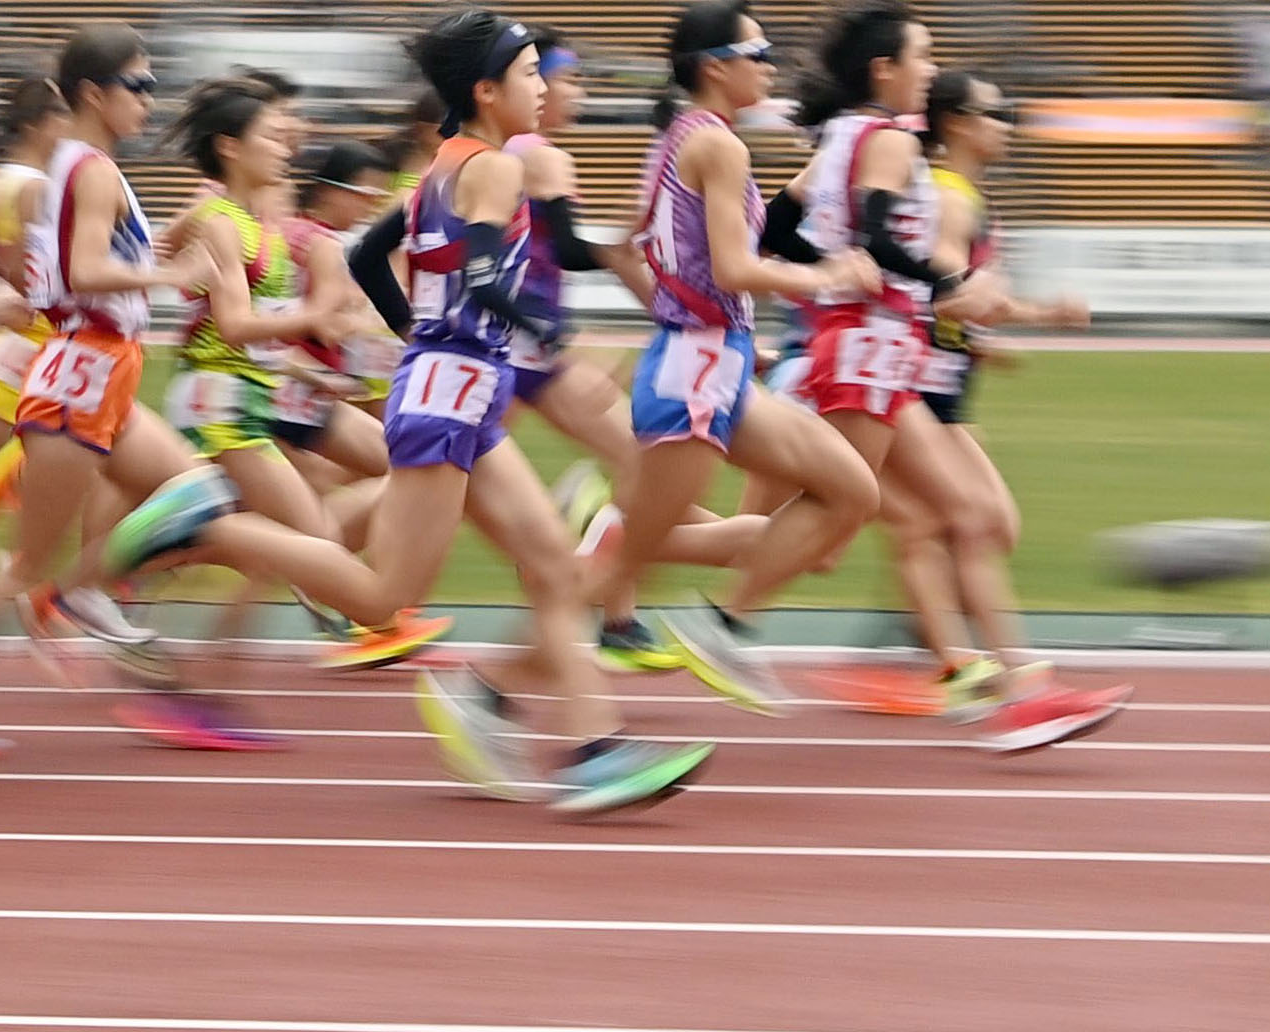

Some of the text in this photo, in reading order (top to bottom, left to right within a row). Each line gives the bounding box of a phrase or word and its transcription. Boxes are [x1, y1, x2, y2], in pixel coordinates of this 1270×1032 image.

[40, 348, 97, 398] 45
[421, 360, 481, 411] 17
[693, 348, 719, 393] 7
